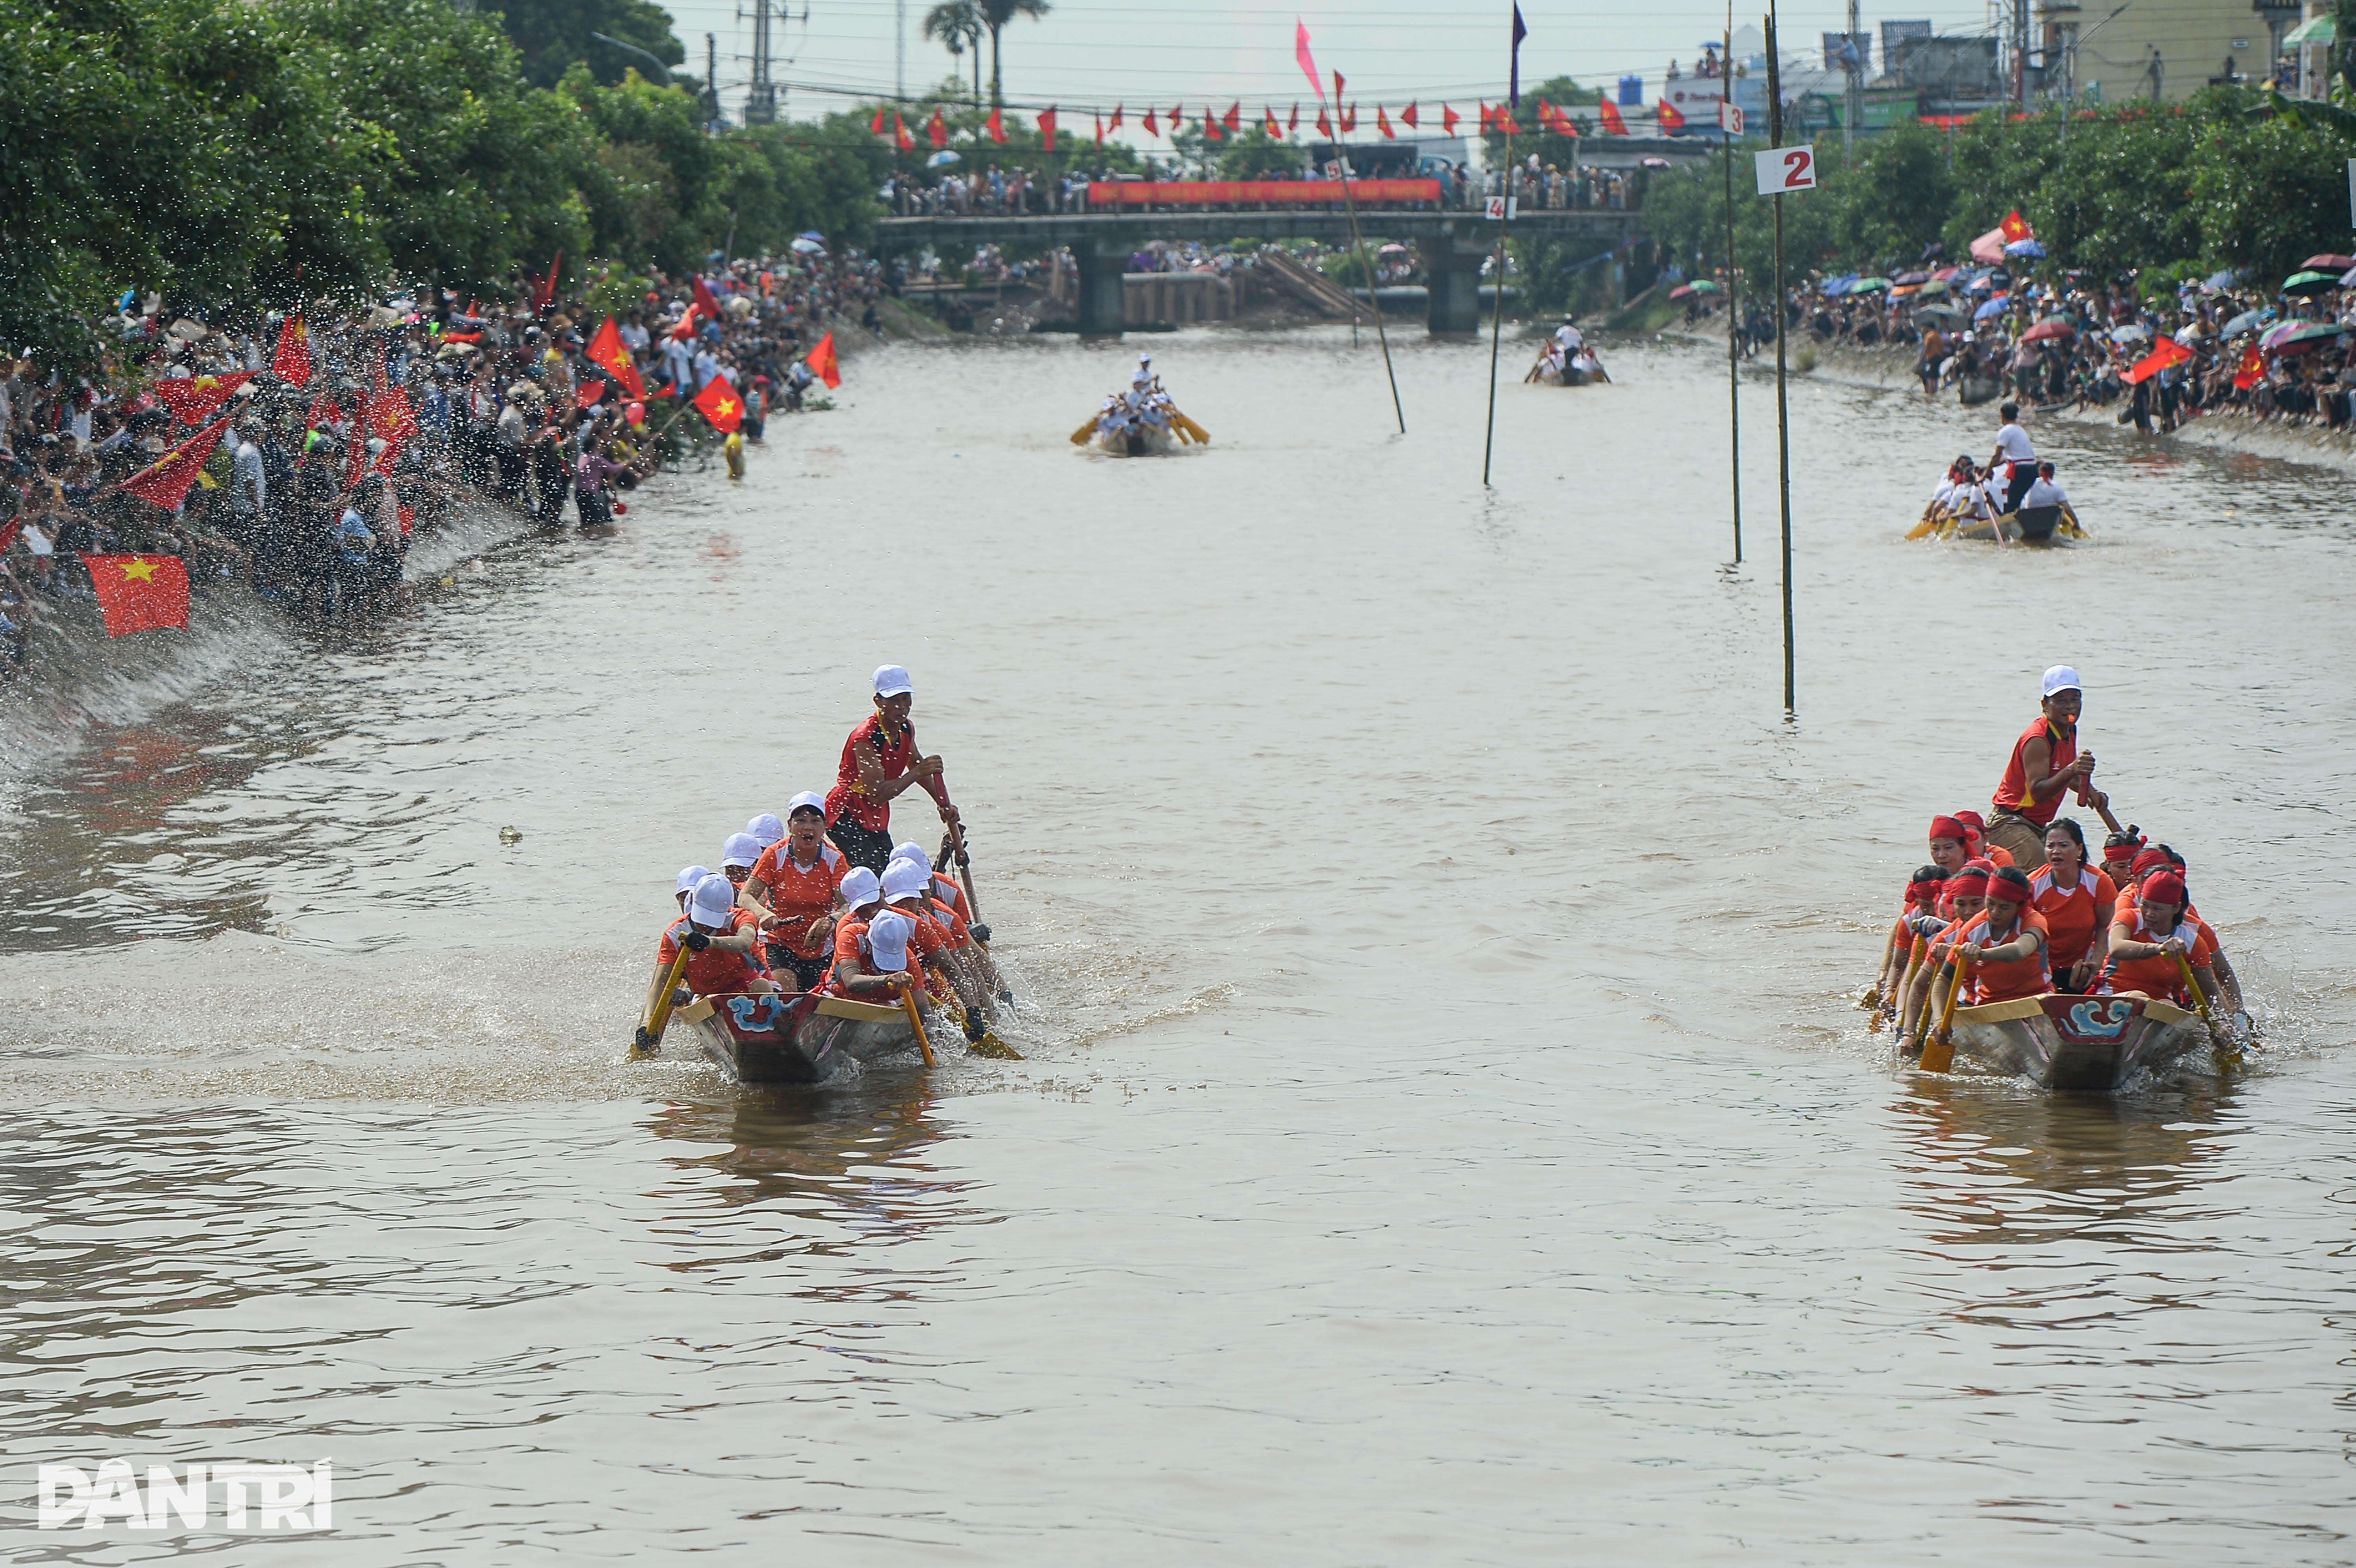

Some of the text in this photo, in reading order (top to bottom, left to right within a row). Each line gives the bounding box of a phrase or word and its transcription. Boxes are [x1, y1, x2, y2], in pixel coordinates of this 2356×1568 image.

[1732, 109, 1742, 132] 3
[1327, 163, 1339, 178] 5
[1784, 151, 1812, 187] 2
[1490, 199, 1504, 216] 4
